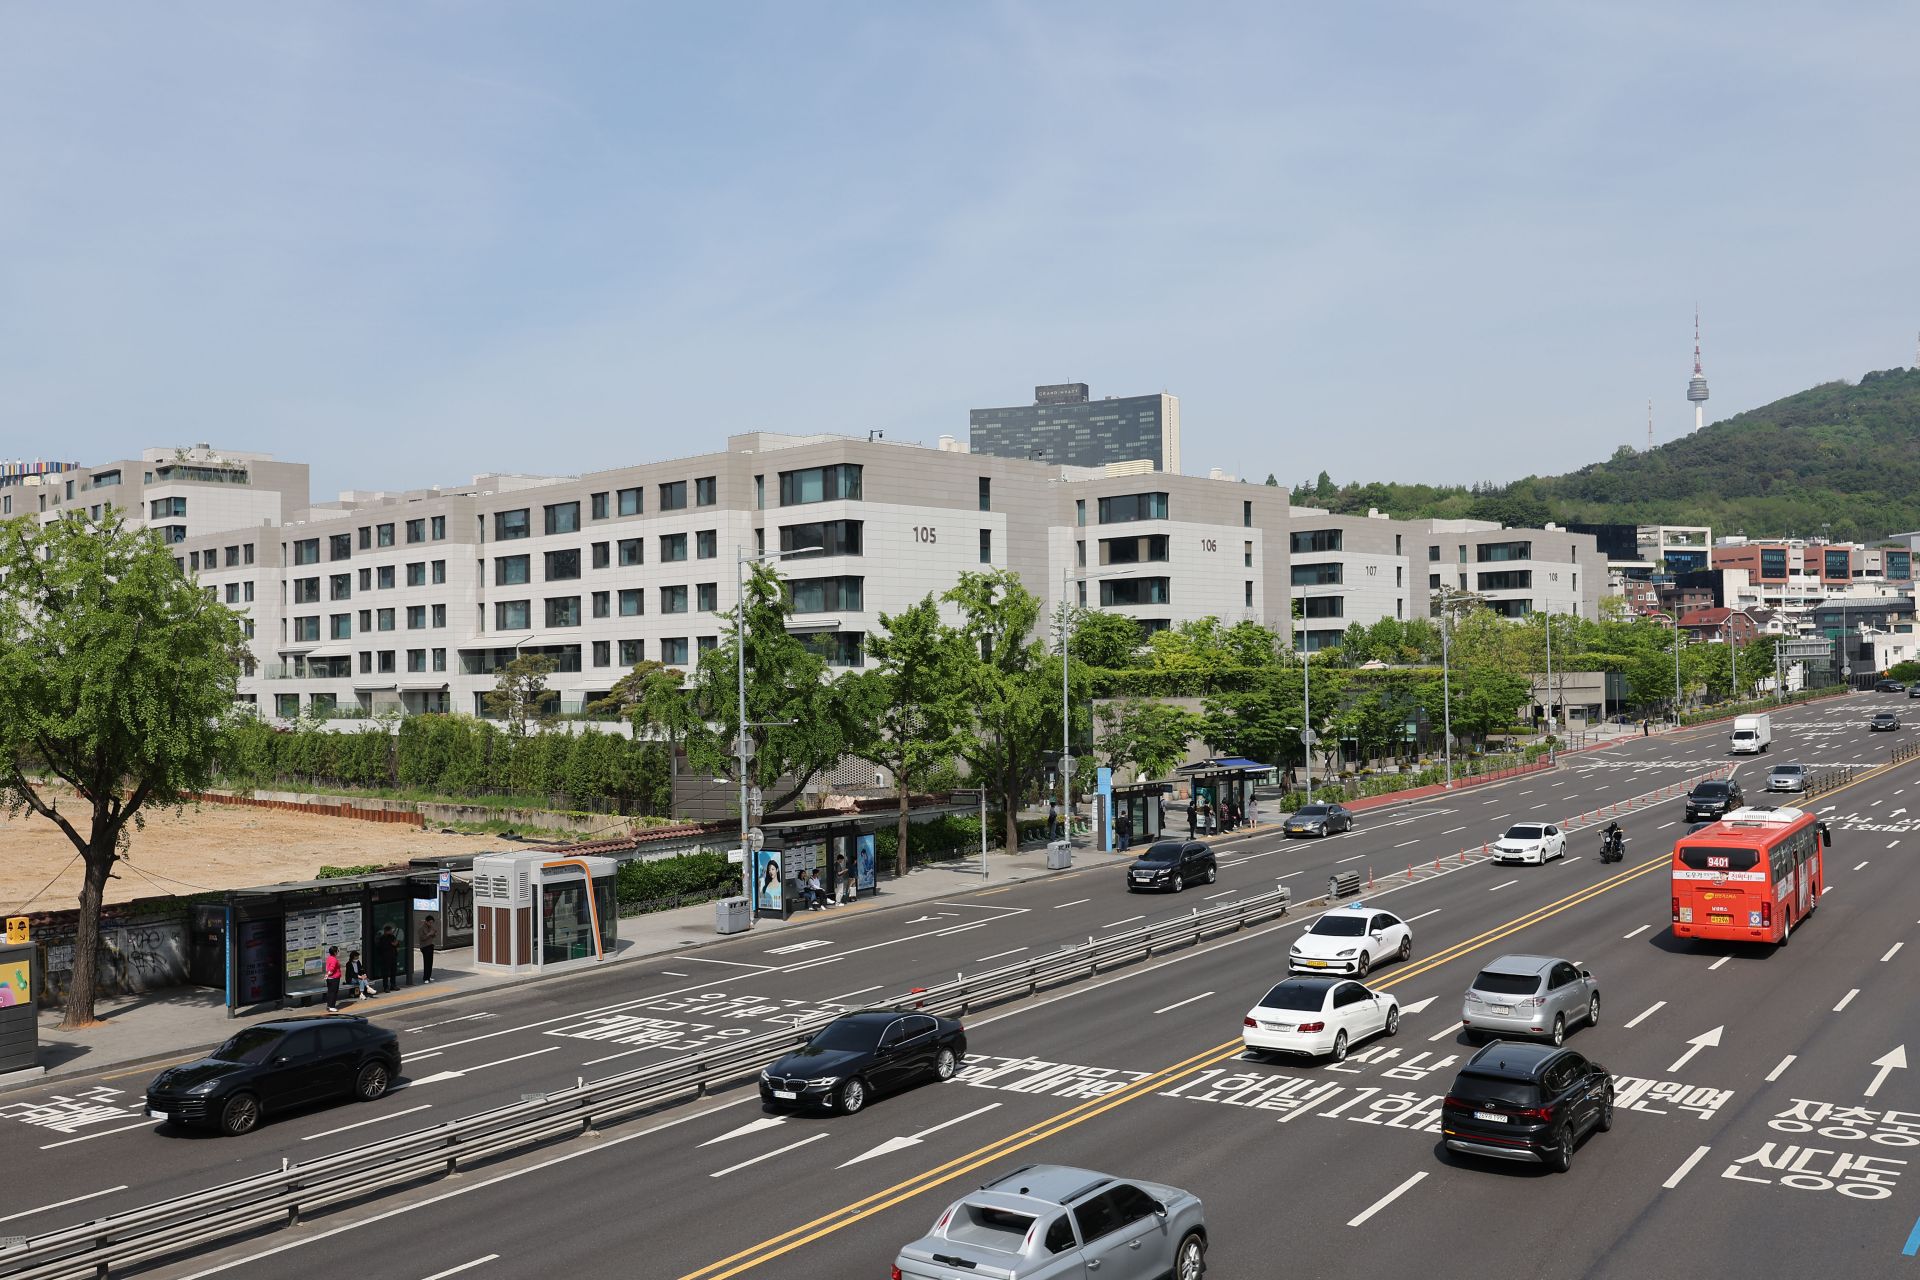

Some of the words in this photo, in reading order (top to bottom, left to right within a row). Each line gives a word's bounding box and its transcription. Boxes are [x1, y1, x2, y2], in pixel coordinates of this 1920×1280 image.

[913, 526, 937, 544] 105
[1201, 539, 1217, 552] 106
[1365, 565, 1377, 577] 107
[1548, 572, 1559, 582] 108
[1708, 857, 1729, 868] 9401
[1157, 1068, 1339, 1111] 1호터널
[1612, 1075, 1735, 1120] 태원역
[1317, 1087, 1443, 1134] 1호터
[1767, 1098, 1920, 1147] 장충동
[1721, 1142, 1908, 1200] 신당동
